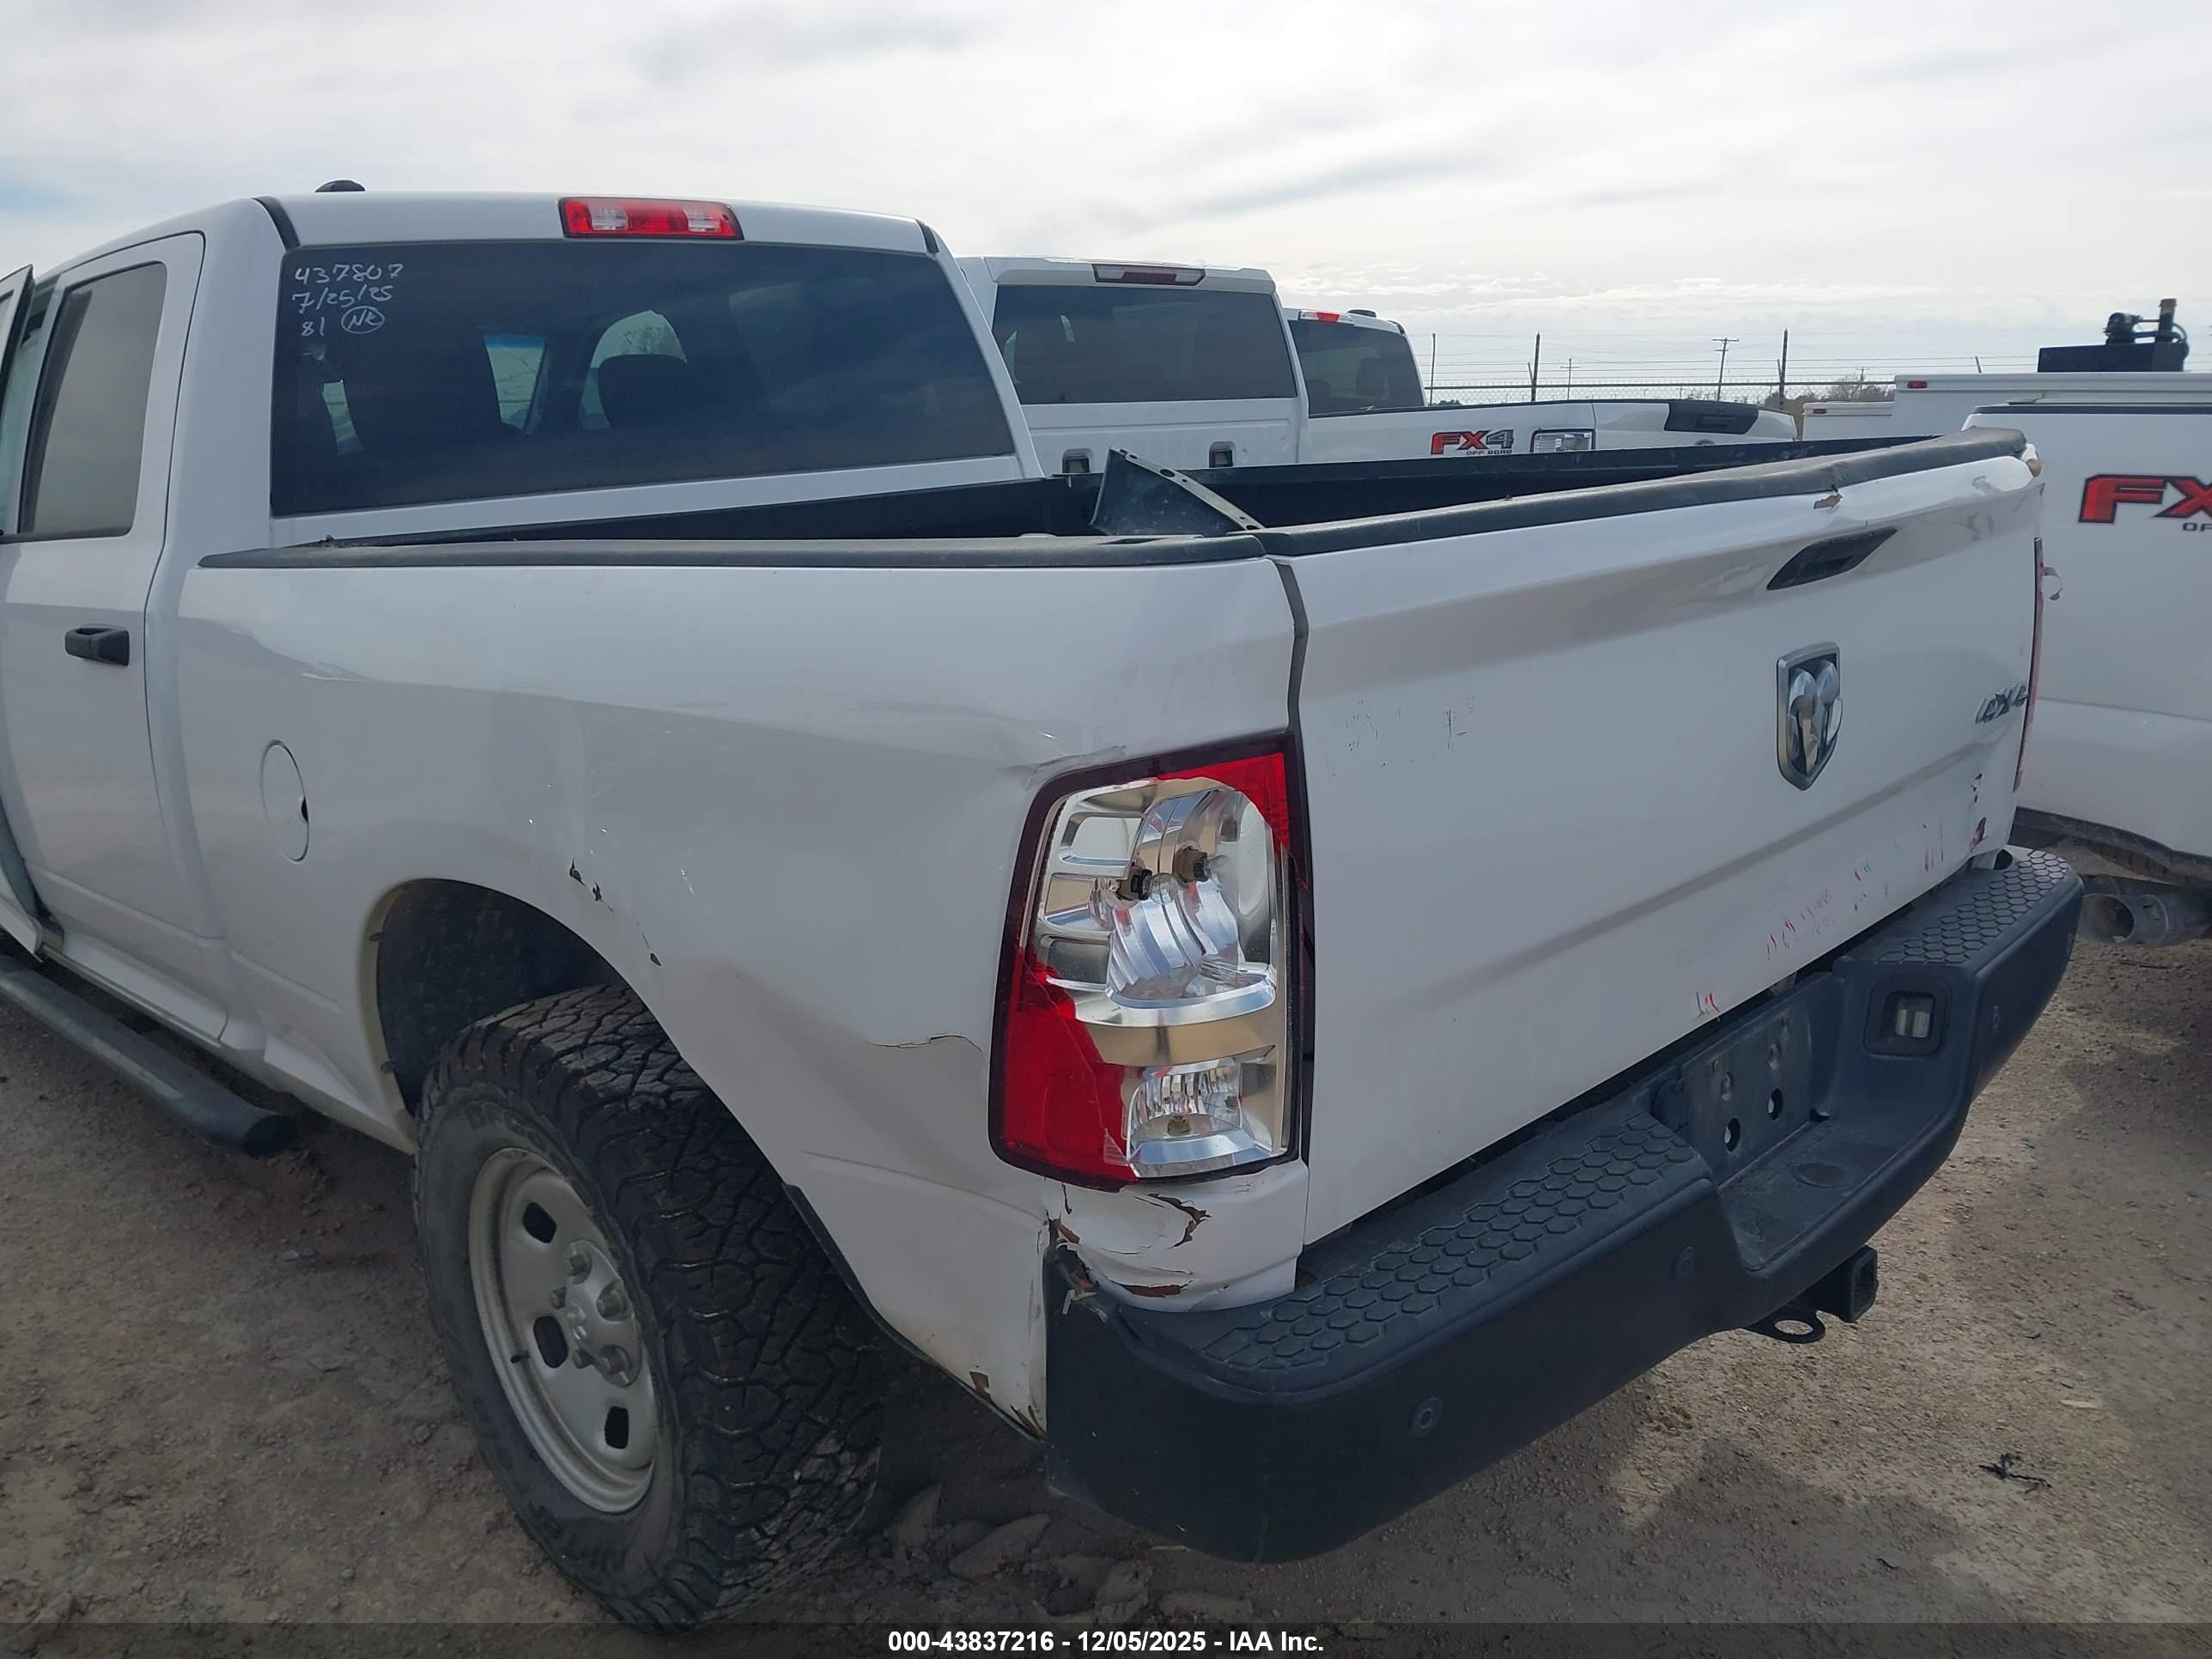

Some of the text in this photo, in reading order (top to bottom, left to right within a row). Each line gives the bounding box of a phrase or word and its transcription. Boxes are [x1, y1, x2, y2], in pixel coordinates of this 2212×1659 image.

[295, 263, 404, 284] 437807
[292, 283, 393, 314] 7/25/25
[1431, 429, 1514, 454] FX4
